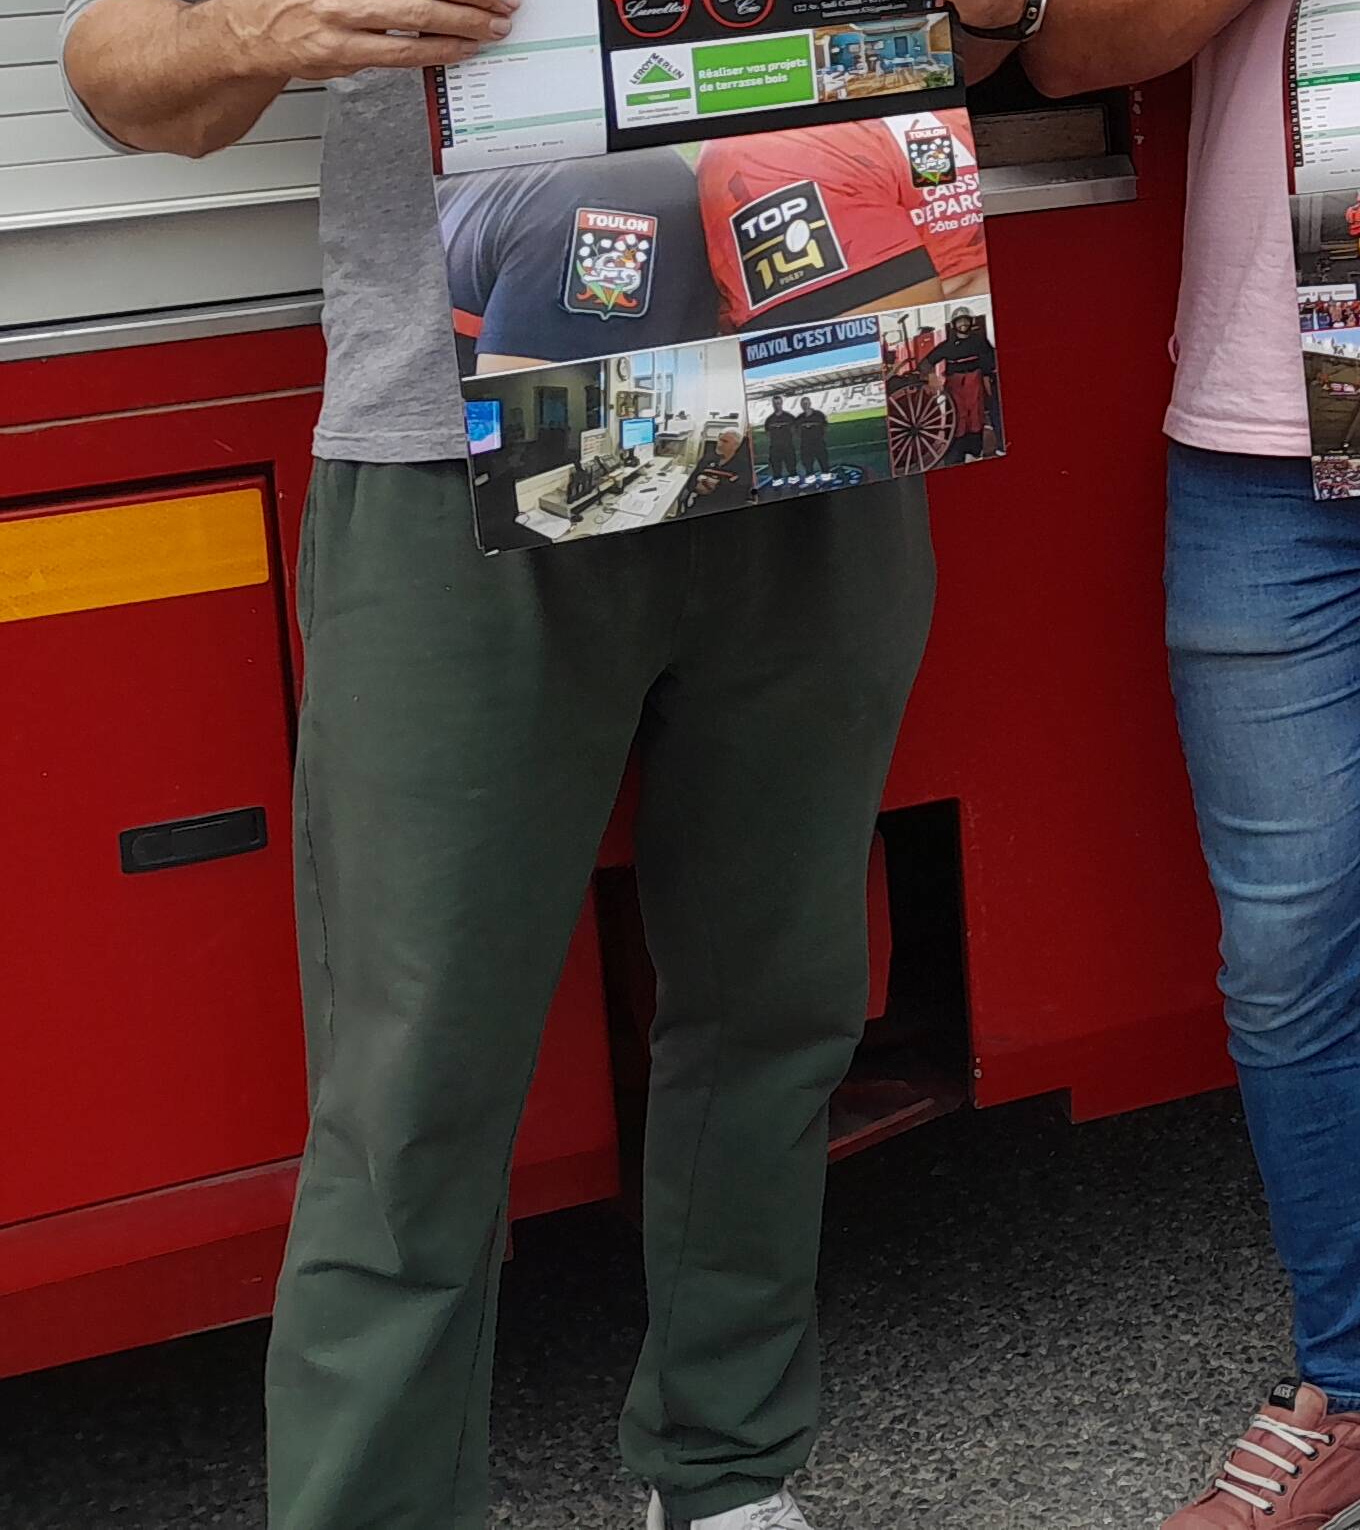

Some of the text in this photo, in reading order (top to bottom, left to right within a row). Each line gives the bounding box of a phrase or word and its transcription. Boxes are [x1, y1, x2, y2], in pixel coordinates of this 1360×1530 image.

[624, 0, 688, 19] Lunettes
[629, 52, 684, 85] LEROY MERLIN
[698, 58, 808, 79] Réaliser vos projets
[699, 72, 788, 92] de terrasse bois
[909, 128, 947, 140] TOULON
[587, 213, 649, 232] TOULON
[741, 197, 808, 239] TOP
[756, 239, 824, 290] 14
[746, 317, 878, 362] MAYOL C'EST VOUS
